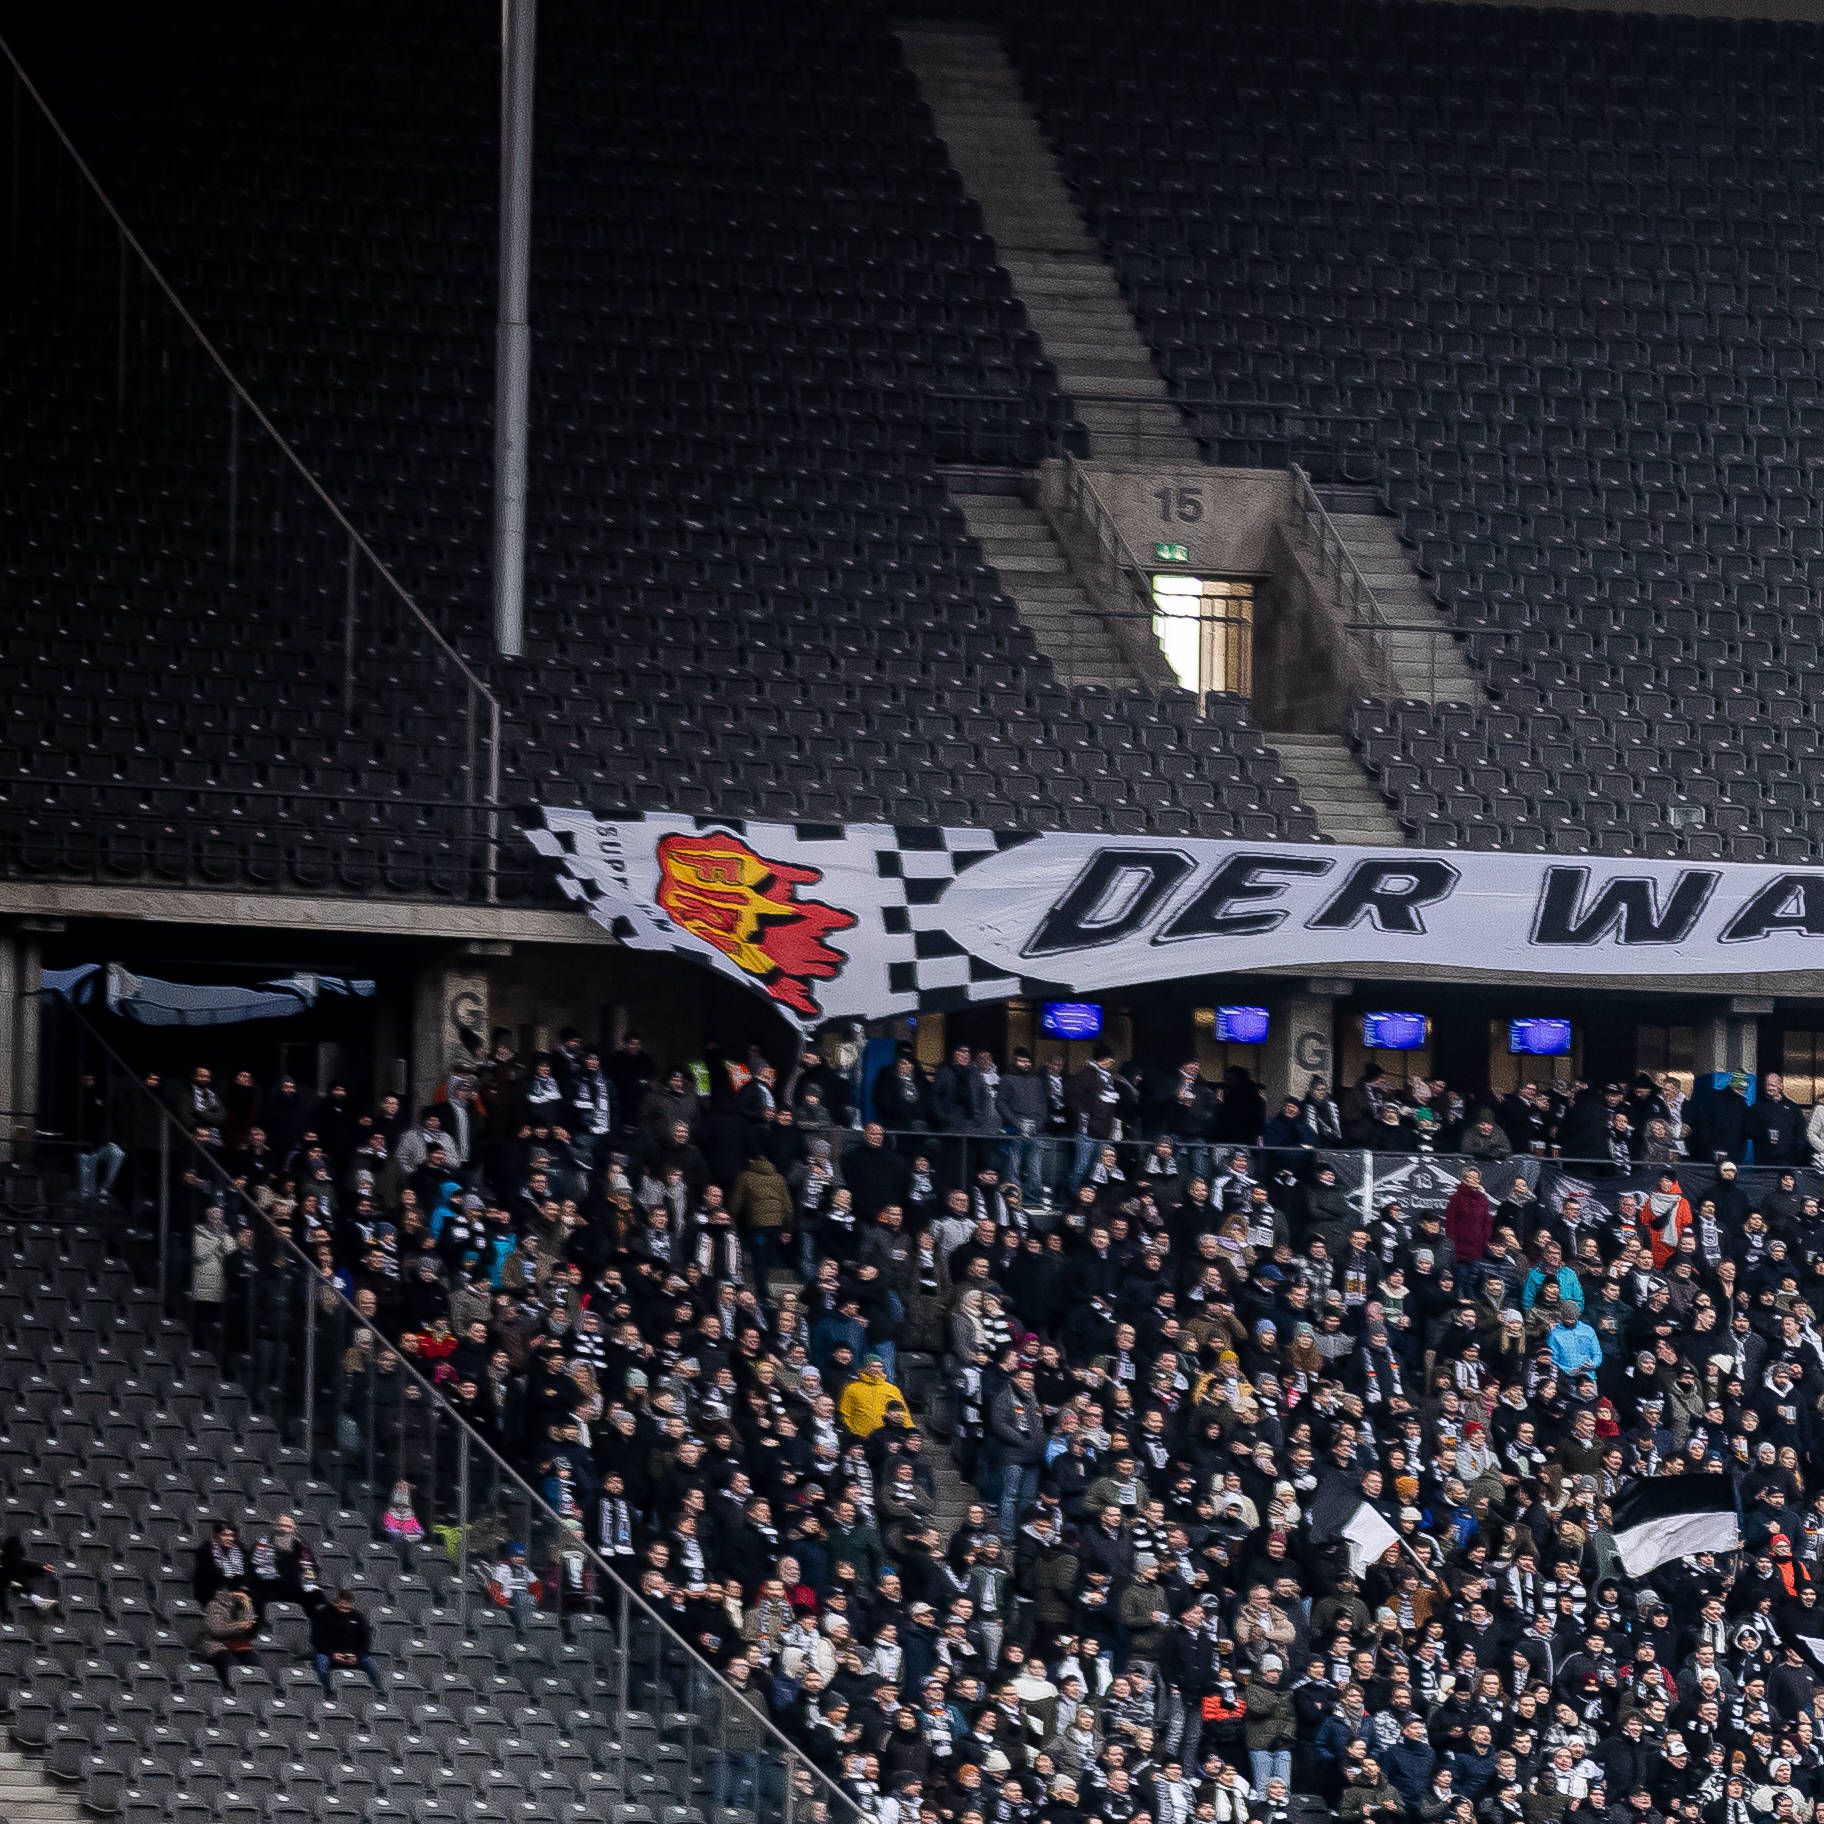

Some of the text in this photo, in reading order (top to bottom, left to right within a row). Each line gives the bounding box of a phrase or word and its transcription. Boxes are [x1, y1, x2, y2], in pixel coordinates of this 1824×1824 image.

[1154, 487, 1203, 524] 15
[1020, 847, 1460, 959] DER
[1295, 1030, 1329, 1072] G
